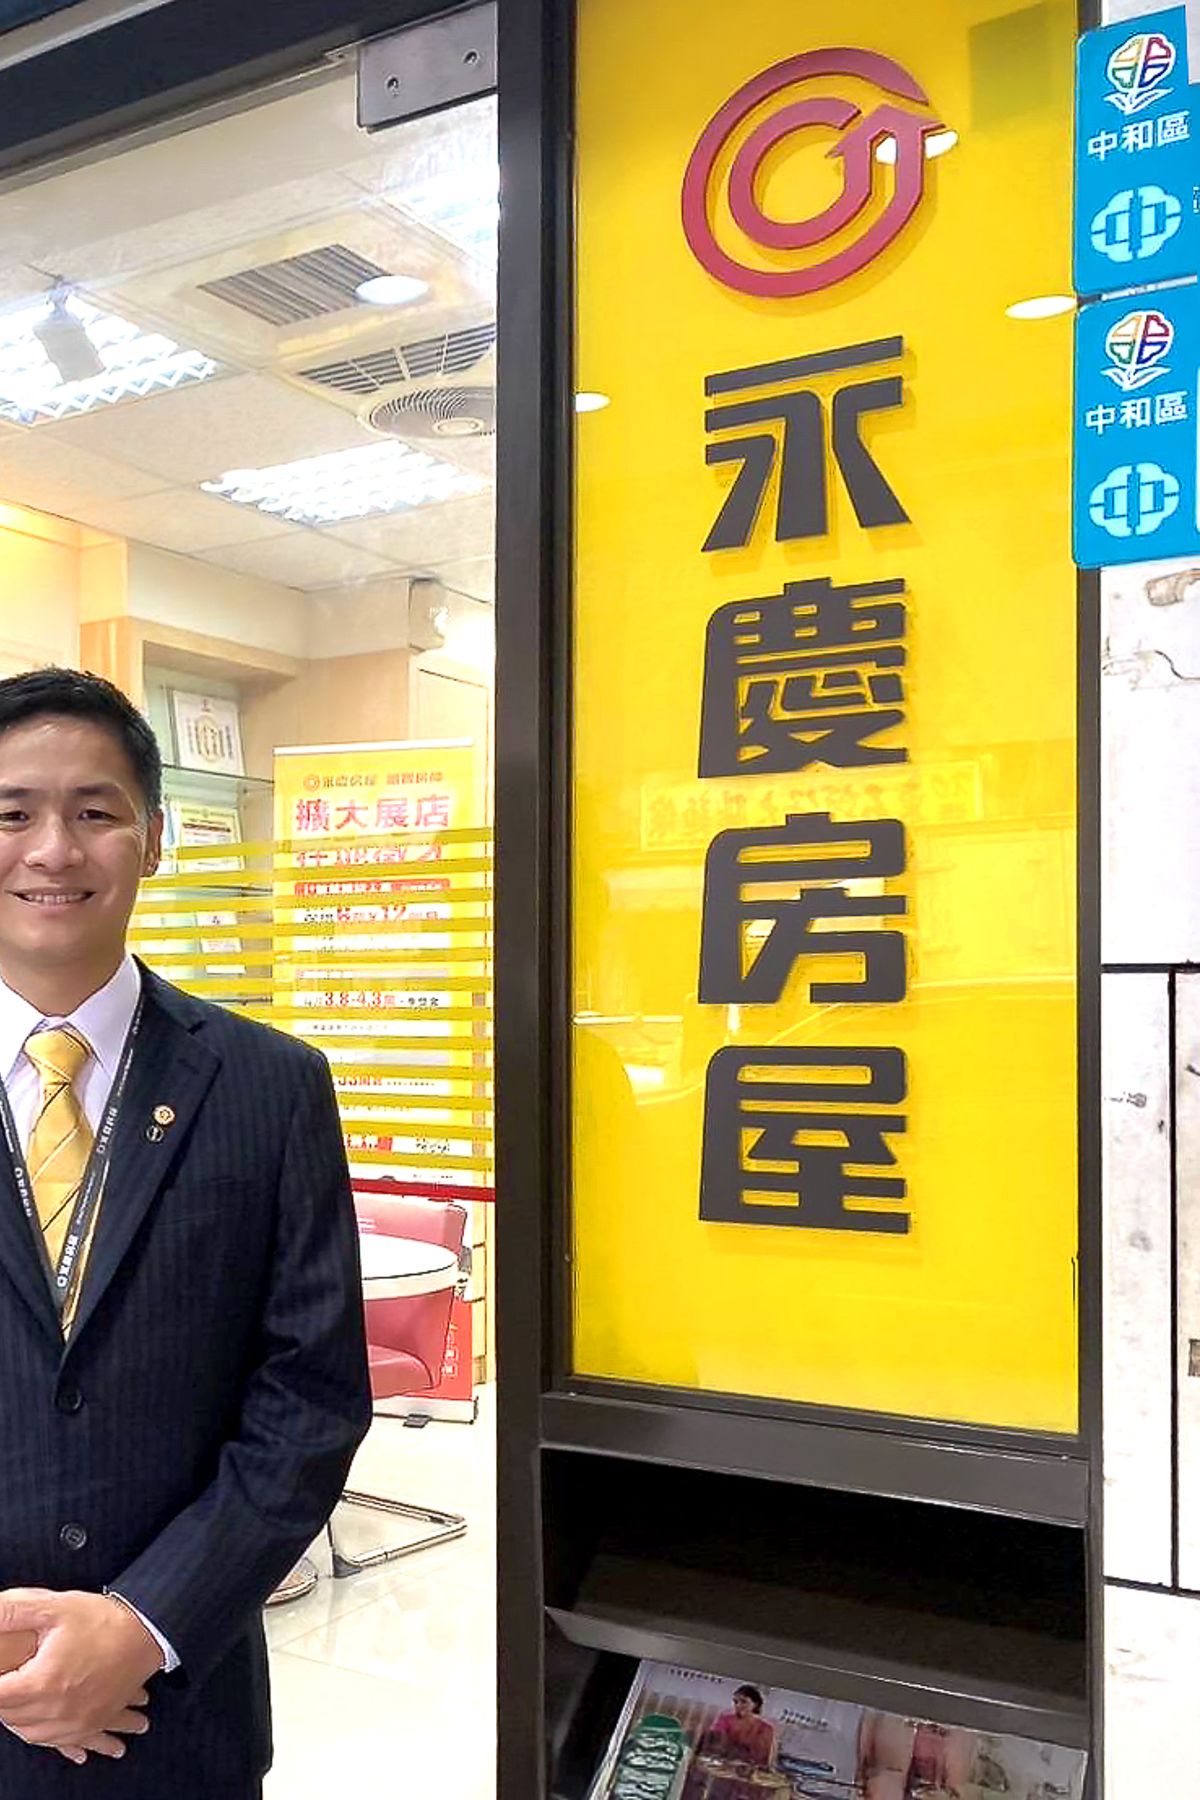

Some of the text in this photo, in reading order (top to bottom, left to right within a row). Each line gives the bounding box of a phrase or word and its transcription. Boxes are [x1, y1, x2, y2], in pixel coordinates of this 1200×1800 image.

[1087, 110, 1191, 162] 中和區
[1085, 390, 1189, 436] 中和區
[698, 335, 912, 1235] 永慶房屋
